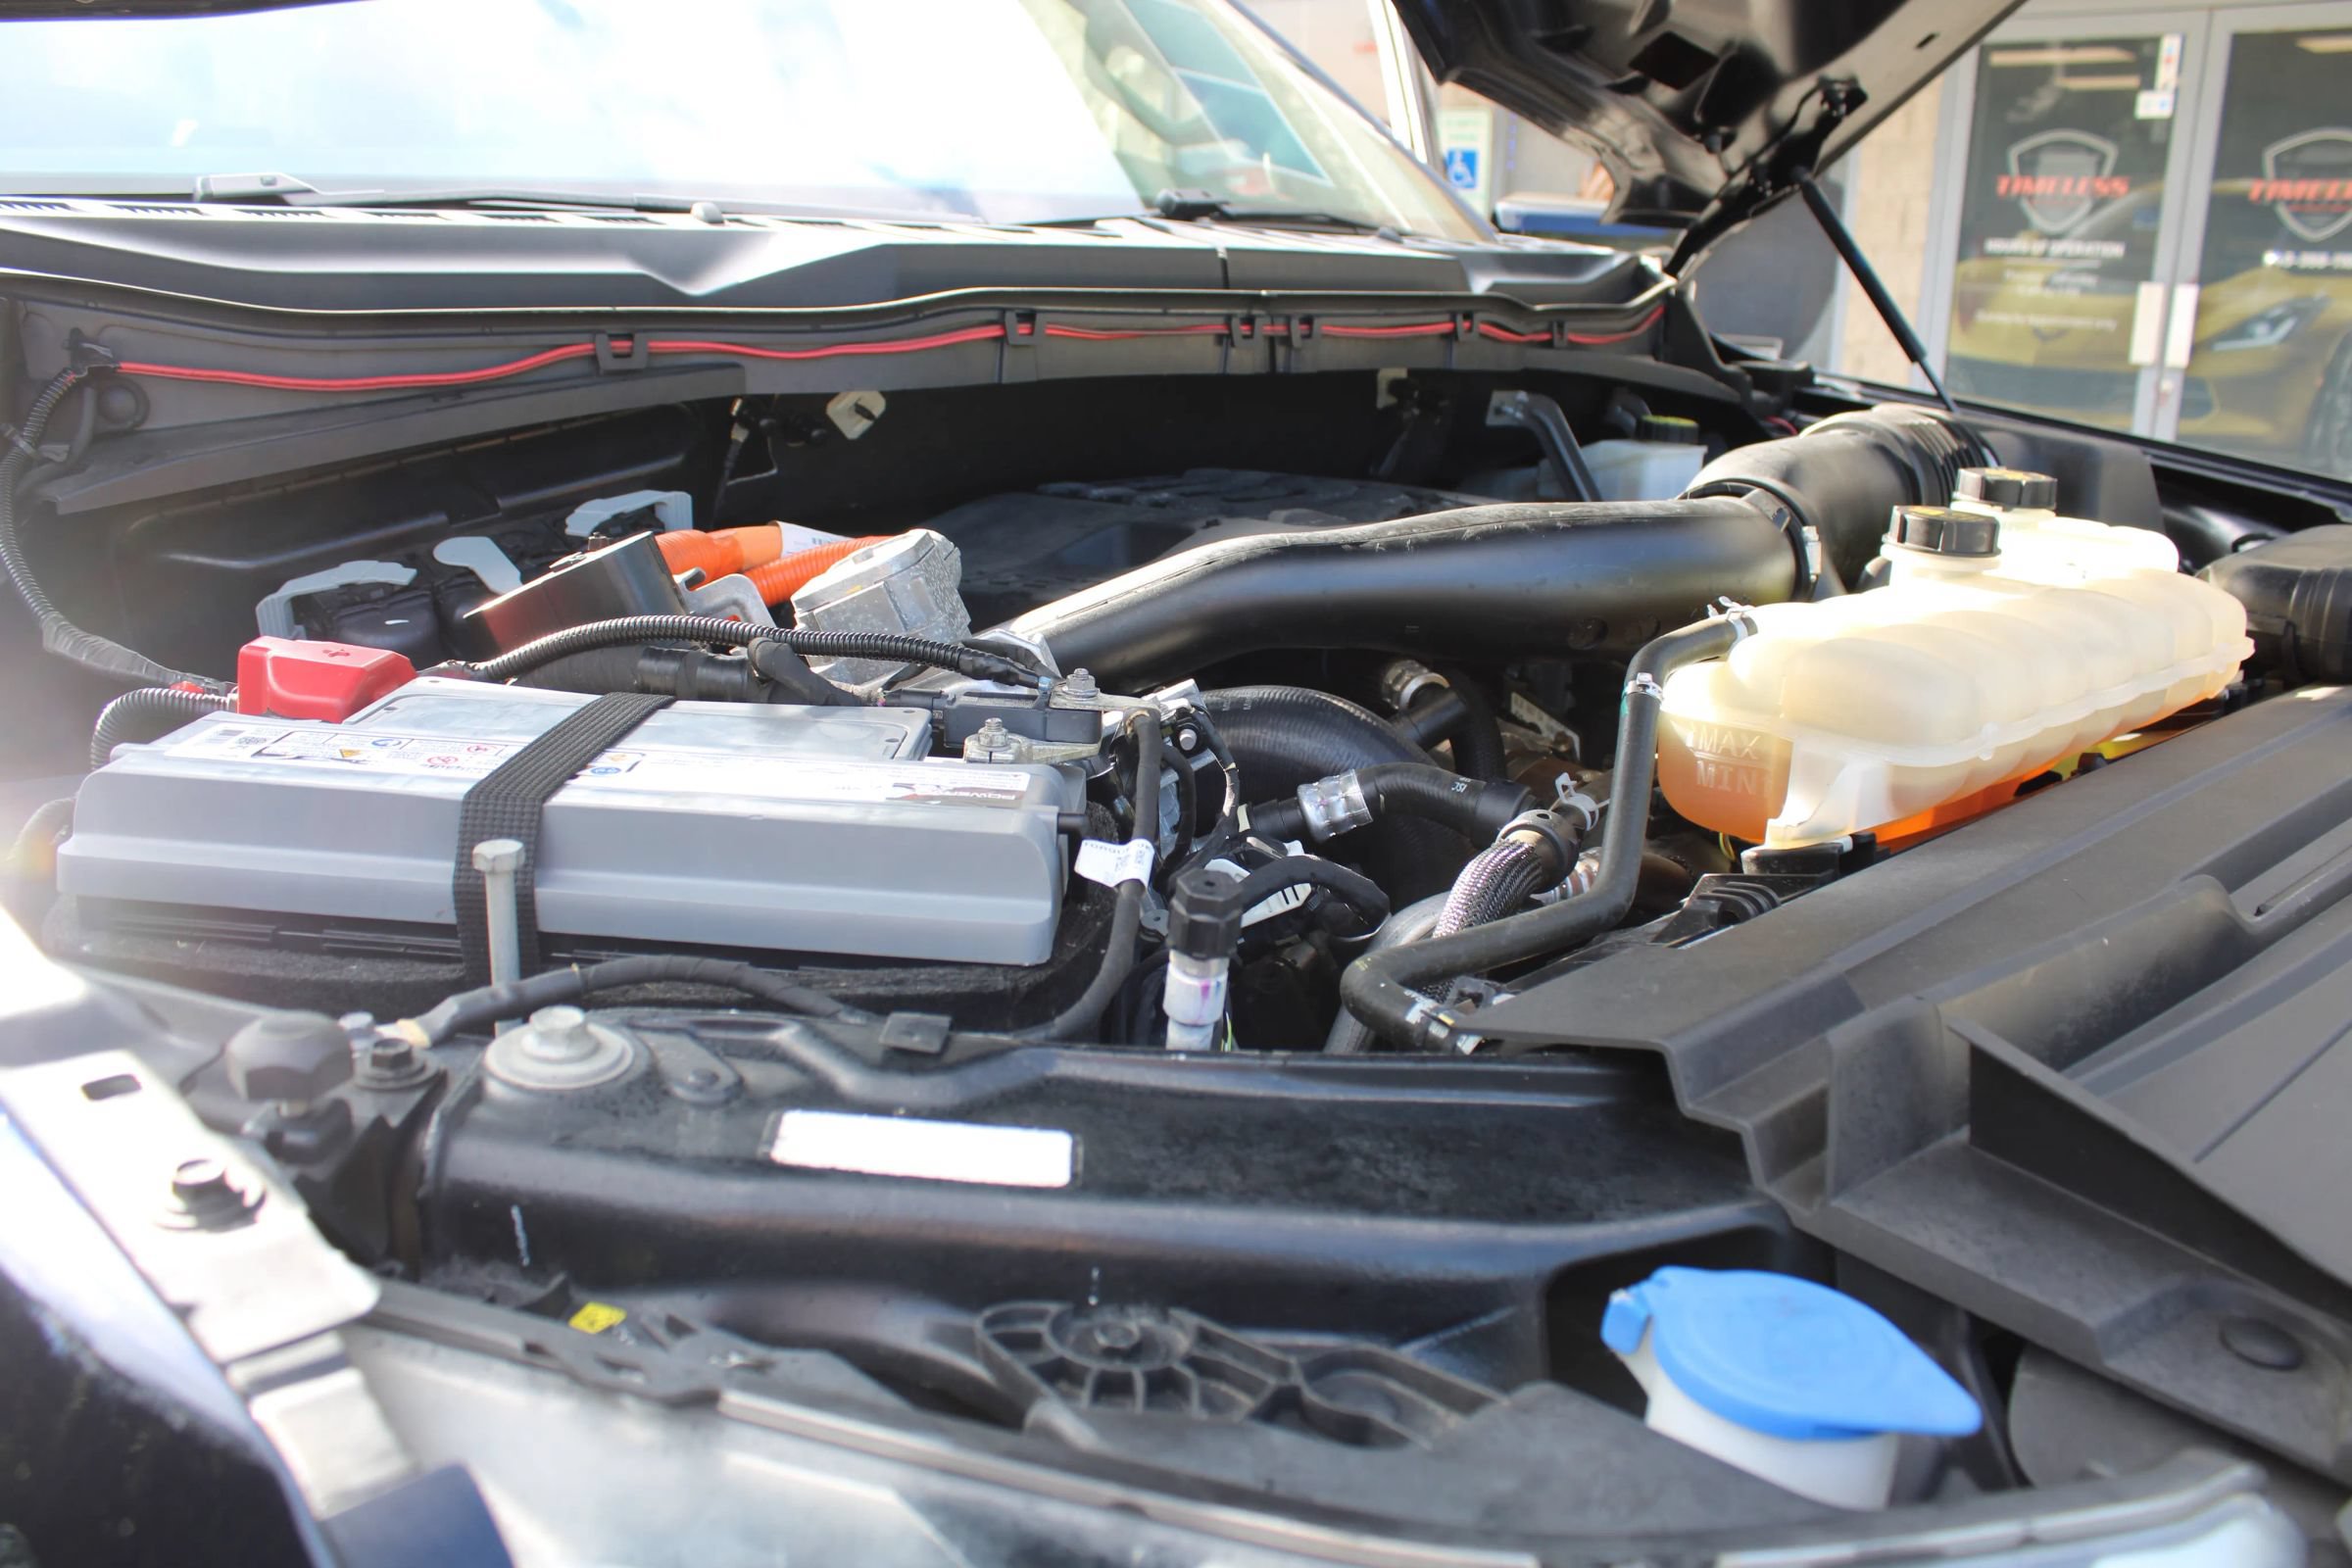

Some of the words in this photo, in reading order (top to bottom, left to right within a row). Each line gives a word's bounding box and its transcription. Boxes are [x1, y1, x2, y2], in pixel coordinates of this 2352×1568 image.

[1996, 175, 2130, 198] TIMELESS
[1697, 725, 1761, 760] MAX
[1696, 760, 1757, 795] MIN
